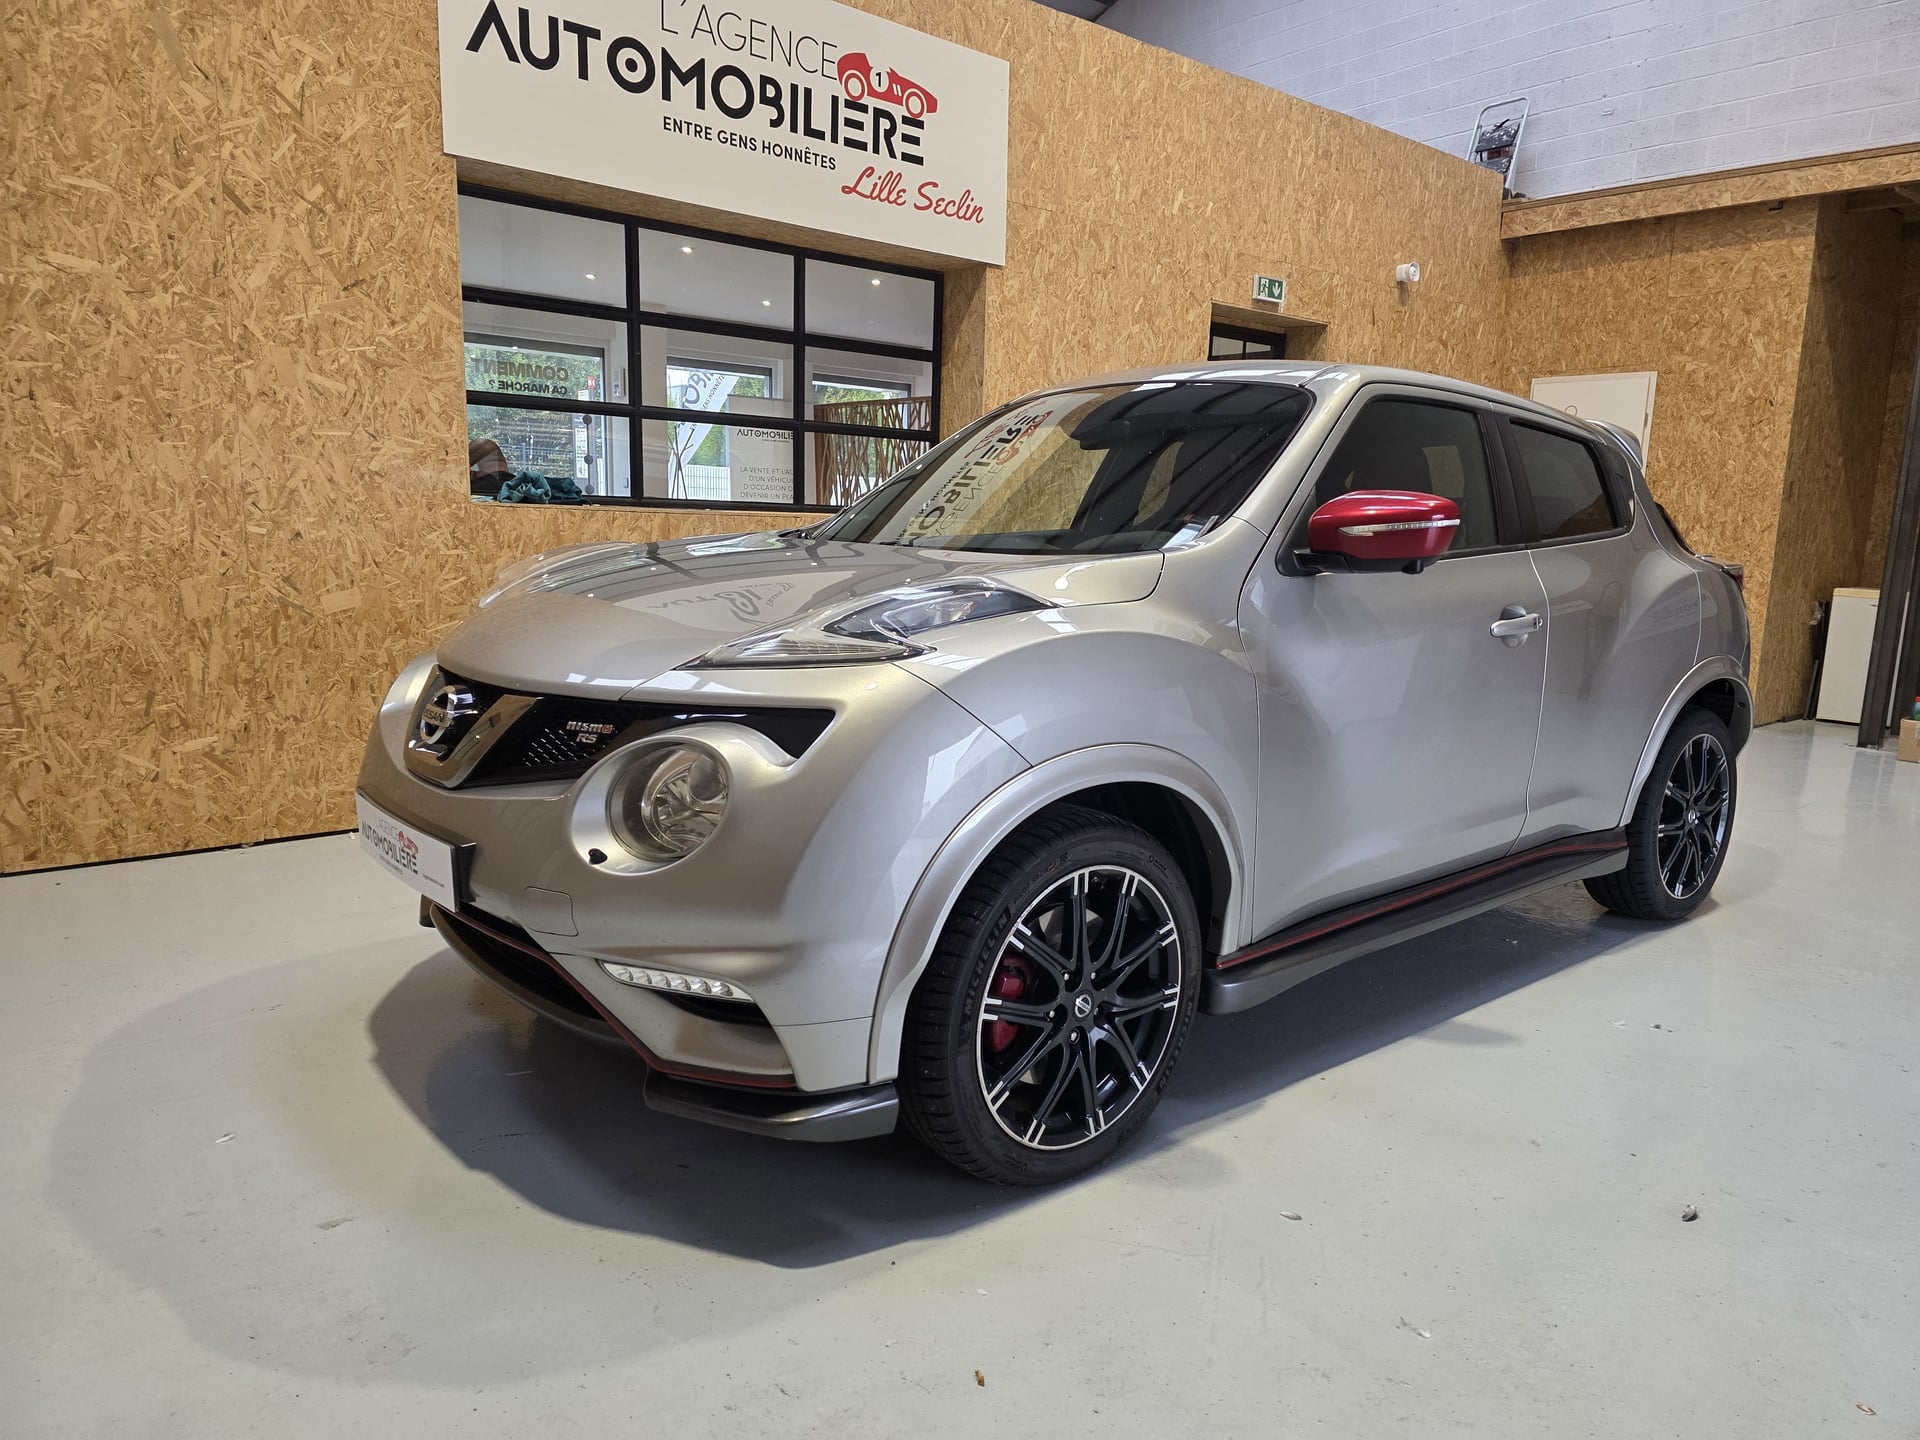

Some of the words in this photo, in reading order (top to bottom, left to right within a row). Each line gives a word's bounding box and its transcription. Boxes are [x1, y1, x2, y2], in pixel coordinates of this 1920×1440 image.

[660, 0, 838, 81] L'AGENCE
[875, 71, 882, 88] 1
[662, 115, 713, 142] ENTRE
[717, 129, 757, 152] GENS
[761, 140, 837, 171] HONNÊTES
[840, 165, 907, 207] Lille
[913, 181, 985, 224] Seclin
[736, 428, 794, 440] AUTOMOBILIE
[749, 466, 771, 474] VENTE
[772, 467, 780, 475] ET
[767, 475, 793, 484] VÉHICU
[743, 483, 786, 492] D'OCCASION
[740, 491, 769, 499] DEVENIR
[576, 733, 598, 743] RS
[963, 907, 1012, 1016] MICHELIN
